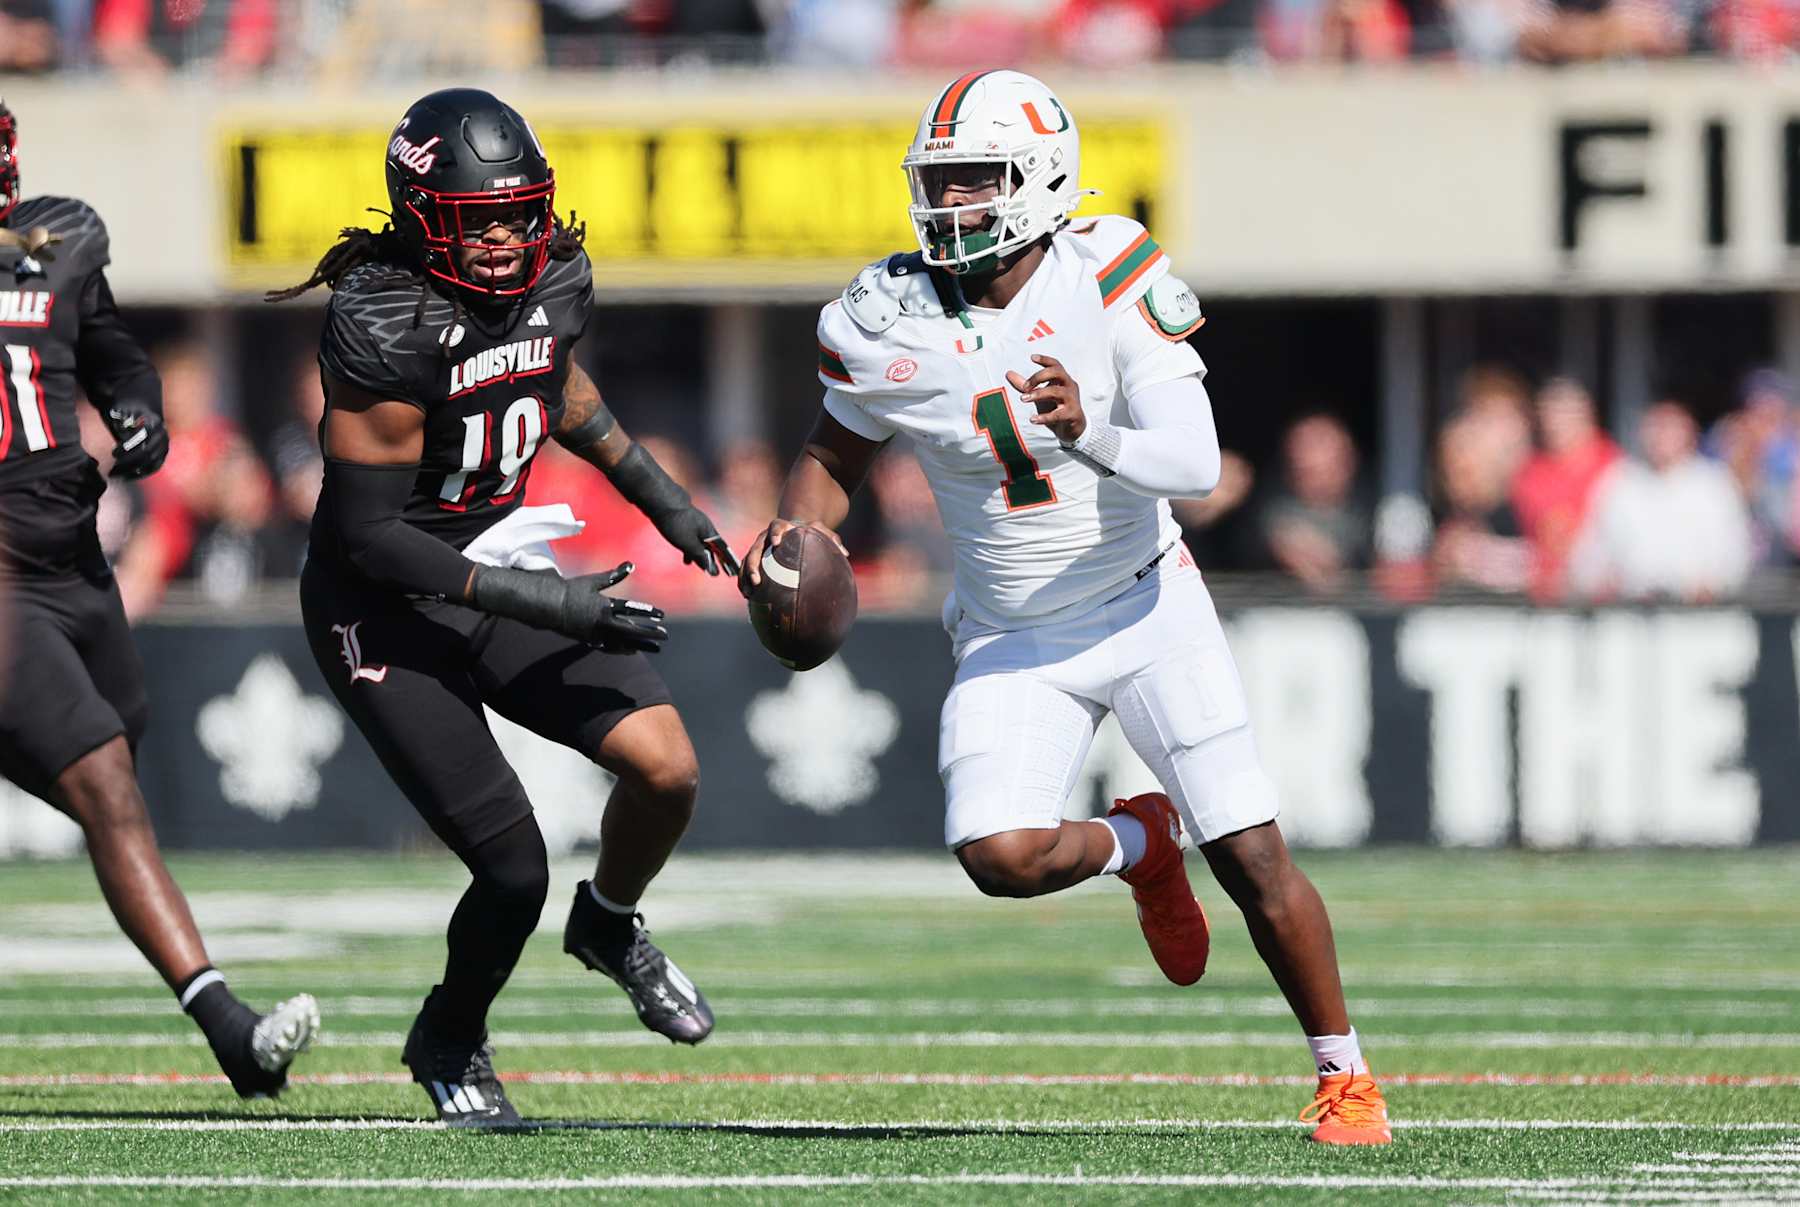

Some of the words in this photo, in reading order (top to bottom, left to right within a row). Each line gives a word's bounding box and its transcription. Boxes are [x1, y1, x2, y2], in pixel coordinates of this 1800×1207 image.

[924, 140, 954, 152] MIAMI
[1020, 98, 1070, 135] U
[0, 290, 53, 328] ILLE
[448, 336, 556, 400] LOUISVILLE
[955, 335, 984, 354] U
[0, 343, 56, 462] 1
[439, 395, 547, 512] 19
[972, 387, 1058, 512] 1
[331, 620, 387, 684] L
[1396, 607, 1761, 849] THE
